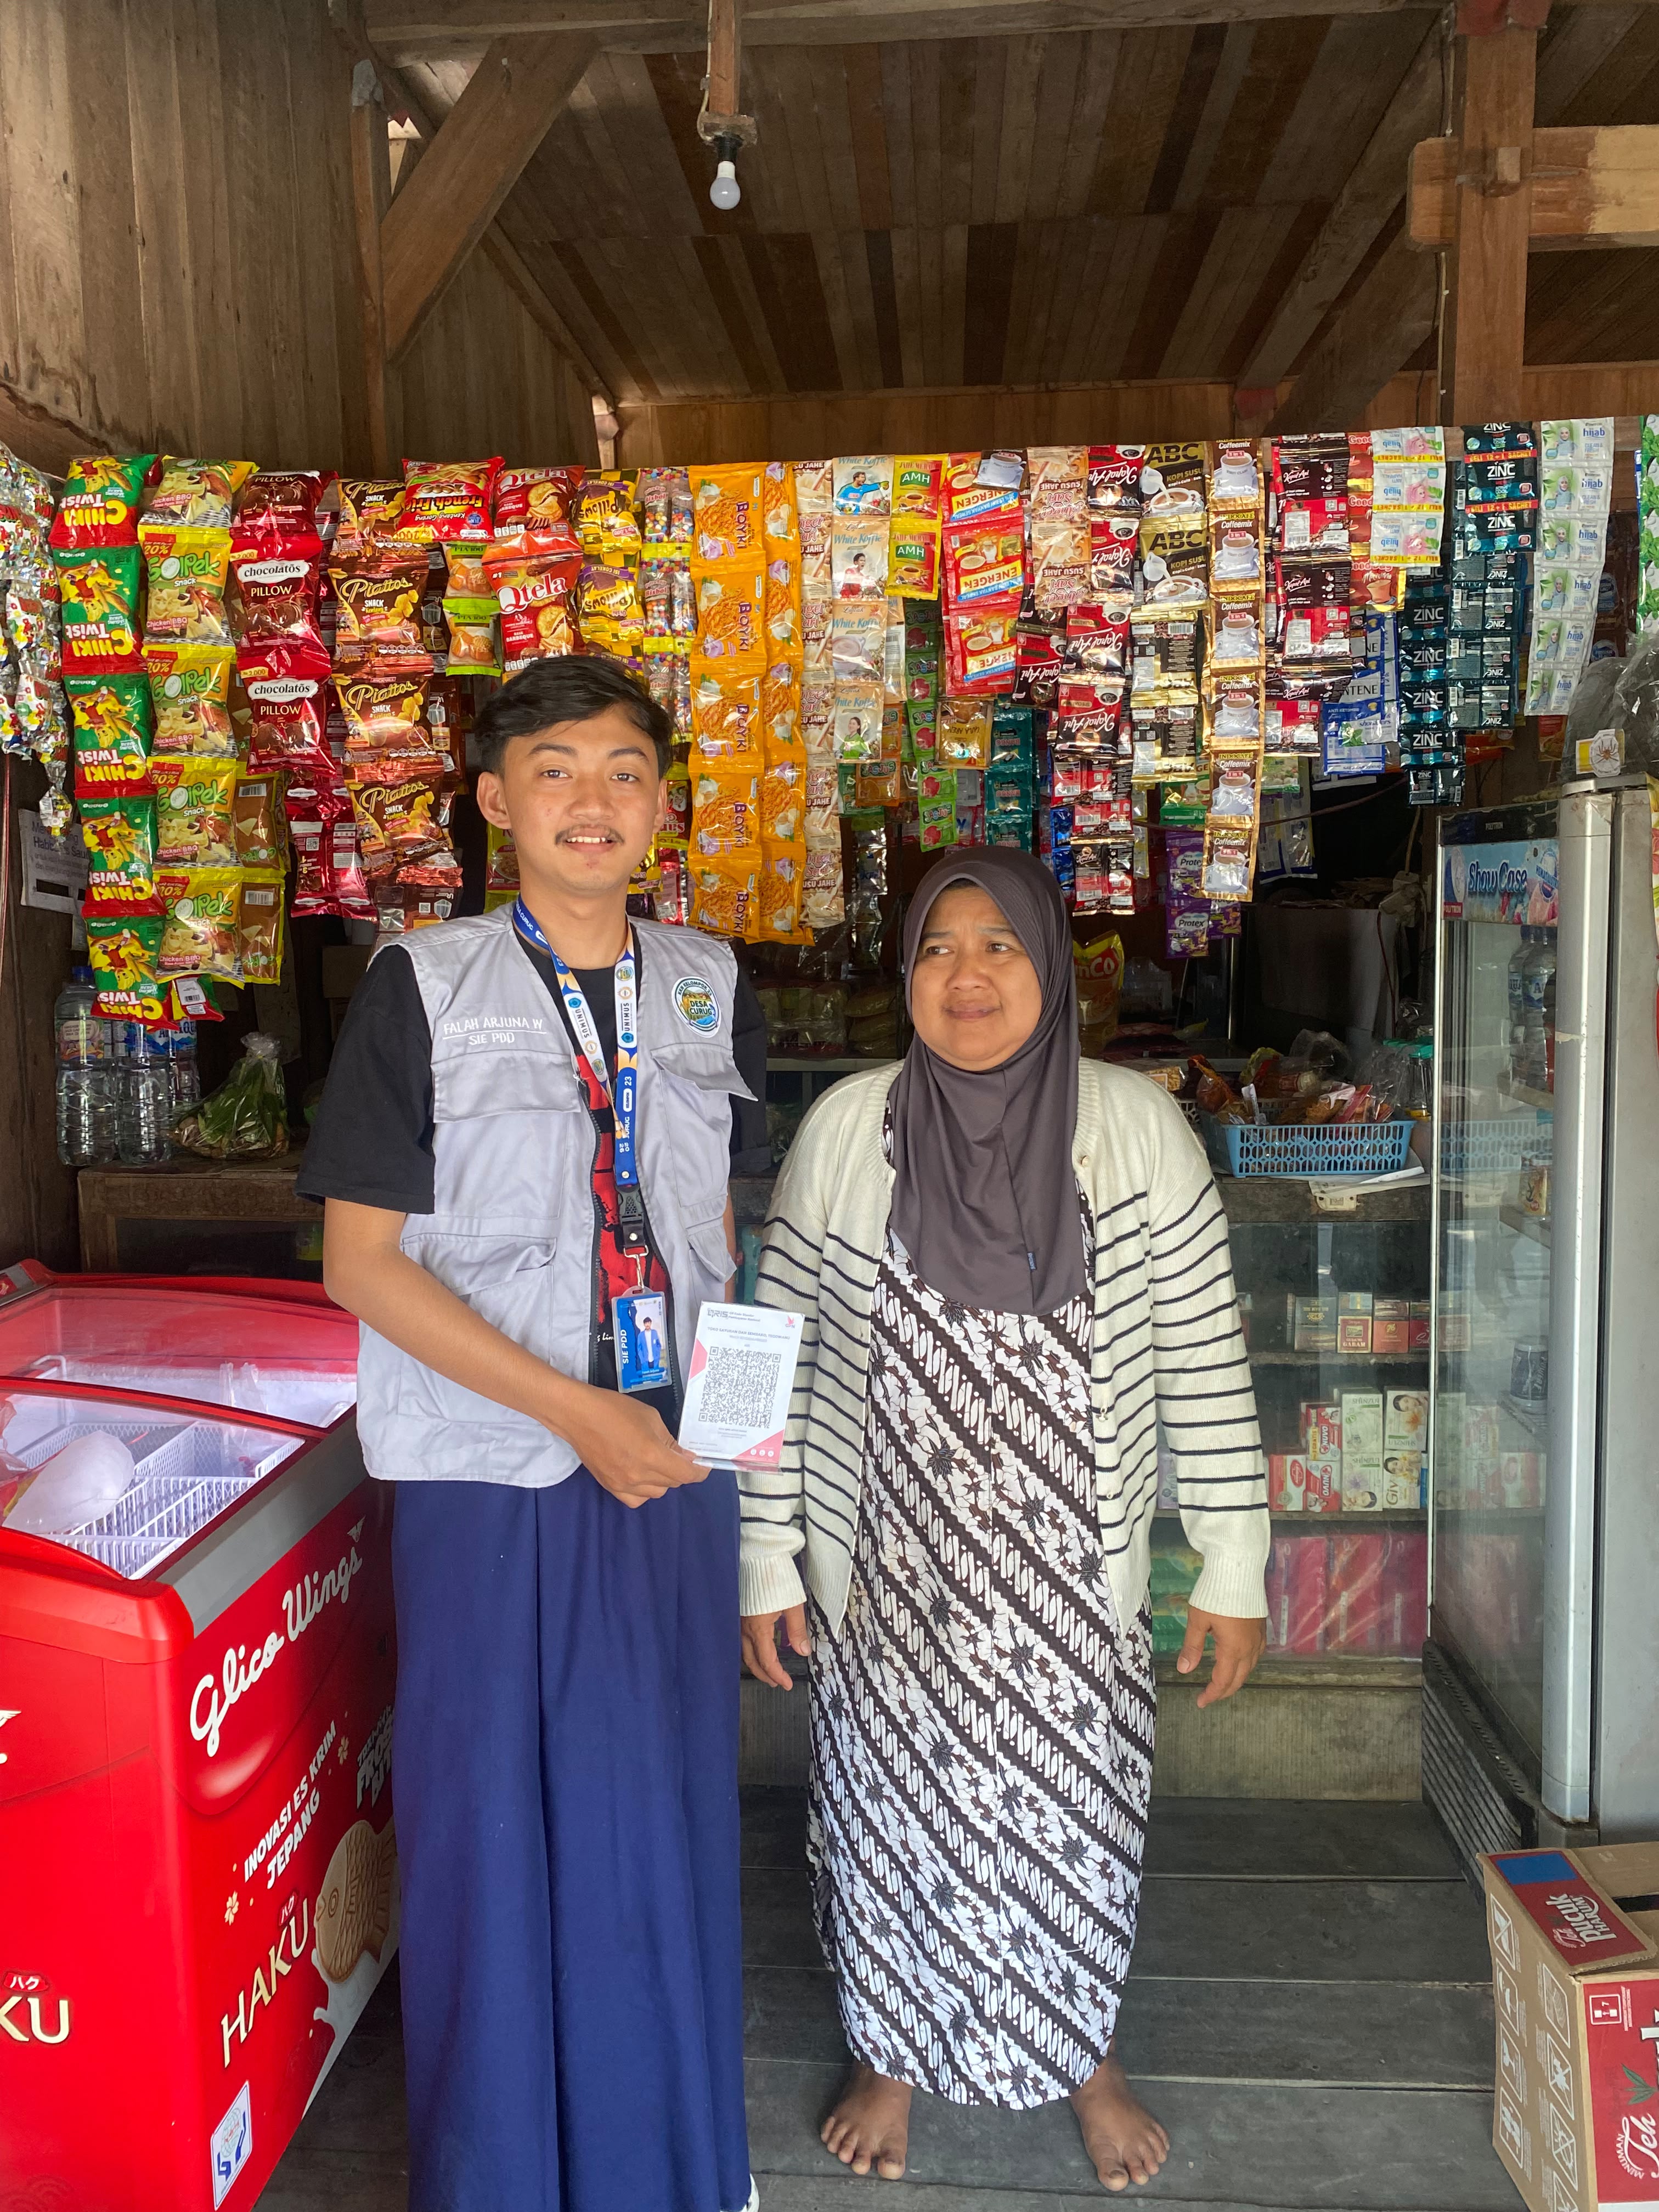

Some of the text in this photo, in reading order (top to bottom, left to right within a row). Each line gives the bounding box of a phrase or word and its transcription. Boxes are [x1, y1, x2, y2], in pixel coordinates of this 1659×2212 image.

[1583, 428, 1605, 438] hijab
[1218, 441, 1251, 449] Coffeemix
[1146, 443, 1199, 465] ABC
[1508, 450, 1532, 459] SACHET
[838, 456, 856, 466] White
[1487, 463, 1516, 478] ZINC
[255, 475, 297, 483] PILLOW
[497, 469, 567, 494] Qtela
[902, 473, 930, 484] AMH
[1166, 472, 1184, 482] KOPI
[1040, 482, 1062, 490] JAHE
[1582, 478, 1602, 489] hijab
[1384, 487, 1401, 496] hijab
[435, 495, 483, 511] French
[1221, 520, 1253, 528] Coffeemix
[1488, 515, 1515, 529] ZINC
[834, 534, 857, 545] White
[1579, 529, 1598, 539] hijab
[1149, 529, 1203, 551] ABC
[1381, 539, 1399, 548] hijab
[806, 544, 825, 553] JAHE
[898, 545, 925, 556] AMH
[1170, 560, 1187, 569] KOPI
[964, 566, 1017, 588] ENERGEN
[1043, 567, 1085, 576] SUSU JAHE
[1575, 580, 1591, 590] hijab
[250, 585, 292, 597] PILLOW
[342, 579, 413, 603] Piattos
[497, 574, 567, 614] Qtela
[365, 599, 384, 608] SNACK
[1221, 601, 1253, 610] Coffeemix
[1414, 606, 1444, 622] ZINC
[833, 619, 856, 628] White
[806, 630, 825, 640] JAHE
[1567, 630, 1584, 641] hijab
[1413, 649, 1444, 664] ZINC
[1221, 681, 1253, 690] Coffeemix
[348, 681, 417, 710] Piattos
[1413, 690, 1444, 705] ZINC
[259, 703, 302, 716] PILLOW
[371, 704, 391, 714] SNACK
[809, 715, 827, 723] JAHE
[1413, 732, 1443, 747] ZINC
[1219, 759, 1251, 768] Coffeemix
[360, 781, 429, 814] Piattos
[811, 797, 831, 806] JAHE
[385, 804, 404, 815] SNACK
[1214, 837, 1245, 846] Coffeemix
[817, 879, 836, 887] JAHE
[1178, 918, 1206, 927] Protex
[443, 1017, 543, 1035] FALAH ARJUNA W
[575, 1008, 590, 1039] UNIMUS
[468, 1032, 515, 1045] SIE PDD
[624, 1076, 632, 1086] 23
[620, 1329, 628, 1350] PDD
[190, 1546, 363, 1758] Glico Wings
[244, 1719, 336, 1883] INOVASI ES KRIM
[267, 1786, 320, 1889] JEPANG
[1545, 1893, 1617, 1943] pucuk
[1572, 1896, 1611, 1932] HARUM
[221, 1898, 308, 2069] HAKU
[0, 1996, 70, 2044] KU
[1616, 2133, 1645, 2180] MINUMAN
